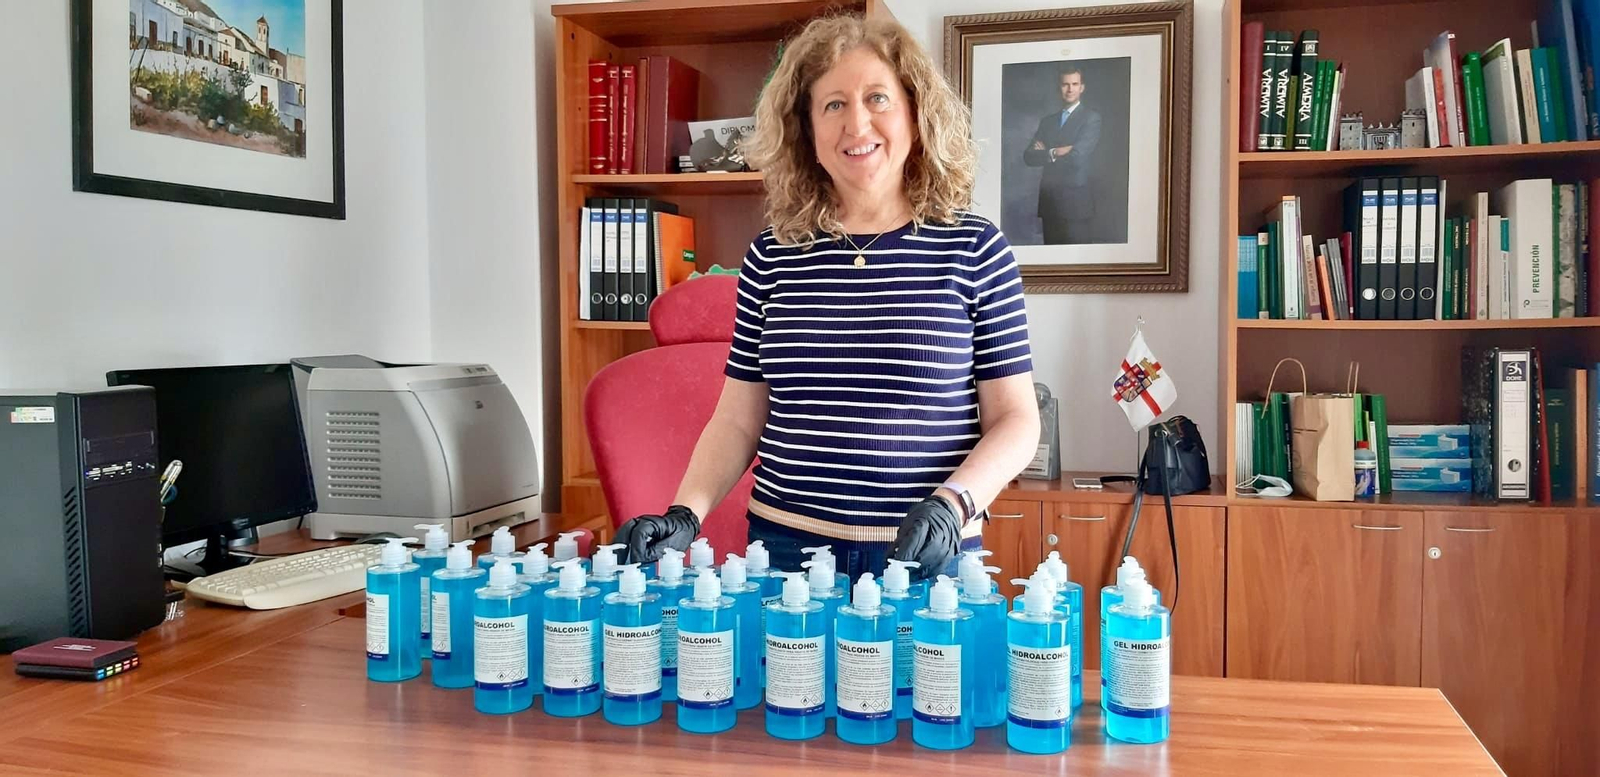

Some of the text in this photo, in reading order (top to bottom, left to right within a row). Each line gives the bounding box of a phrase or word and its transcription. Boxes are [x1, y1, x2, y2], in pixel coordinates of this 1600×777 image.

[1530, 244, 1540, 294] PREVENCIÓN
[605, 628, 615, 638] GEL
[1113, 640, 1129, 650] GEL
